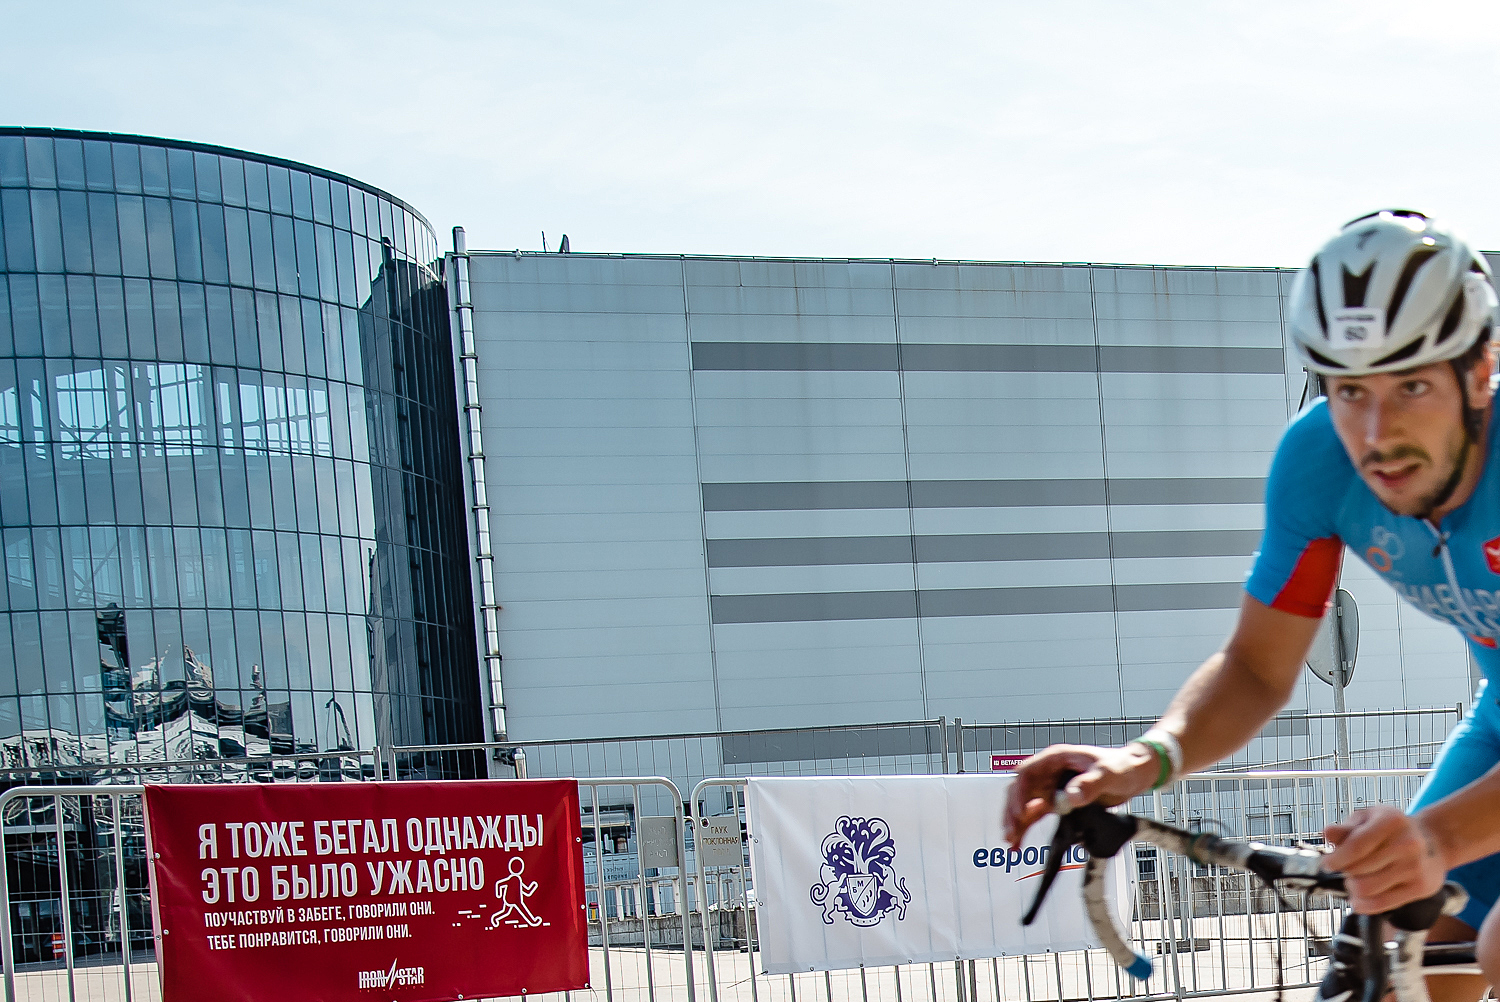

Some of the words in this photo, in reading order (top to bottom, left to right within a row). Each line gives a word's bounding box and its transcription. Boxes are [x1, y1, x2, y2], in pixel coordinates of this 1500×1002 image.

[198, 822, 219, 860] Я
[225, 821, 308, 859] ТОЖЕ
[313, 818, 400, 856] БЕГАЛ
[405, 813, 544, 856] ОДНАЖДЫ
[201, 865, 261, 904] ЭТО
[271, 862, 359, 901] БЫЛО
[366, 856, 485, 896] УЖАСНО
[204, 906, 285, 928] ПОУЧАСТВУЙ
[287, 908, 296, 923] В
[298, 905, 346, 922] ЗАБЕГЕ,
[349, 902, 408, 920] ГОВОРИЛИ
[409, 900, 436, 917] ОНИ.
[206, 934, 237, 951] ТЕБЕ
[239, 929, 321, 949] ПОНРАВИТСЯ,
[324, 925, 384, 943] ГОВОРИЛИ
[386, 923, 413, 939] ОНИ.
